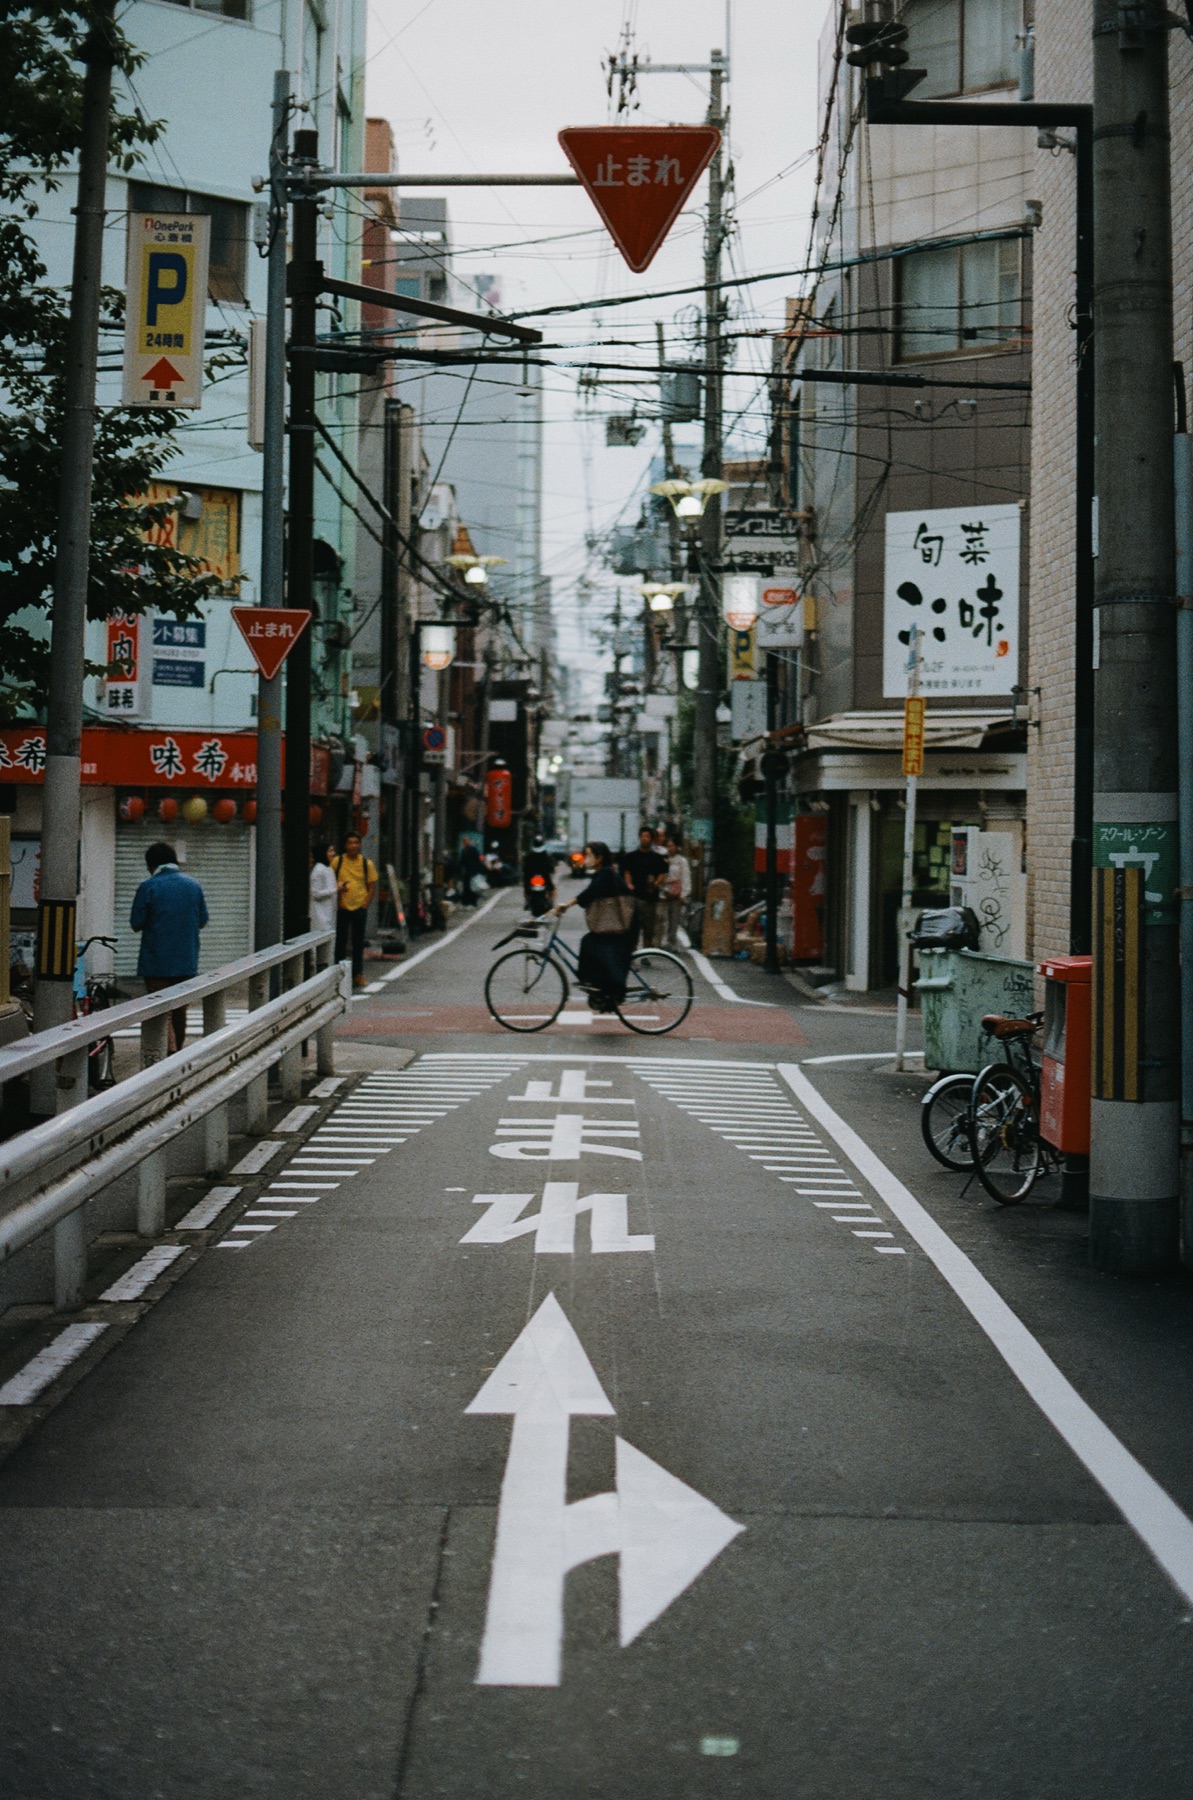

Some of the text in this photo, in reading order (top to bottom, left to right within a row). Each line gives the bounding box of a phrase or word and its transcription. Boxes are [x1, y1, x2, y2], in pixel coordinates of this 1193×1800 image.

[592, 153, 685, 187] 止まれ
[154, 220, 194, 232] OnePark
[146, 252, 187, 326] P
[146, 332, 184, 348] 24時間
[913, 520, 990, 567] 旬菜
[248, 621, 295, 638] 止まれ
[150, 737, 229, 782] 味希
[458, 1069, 655, 1254] 止まれ
